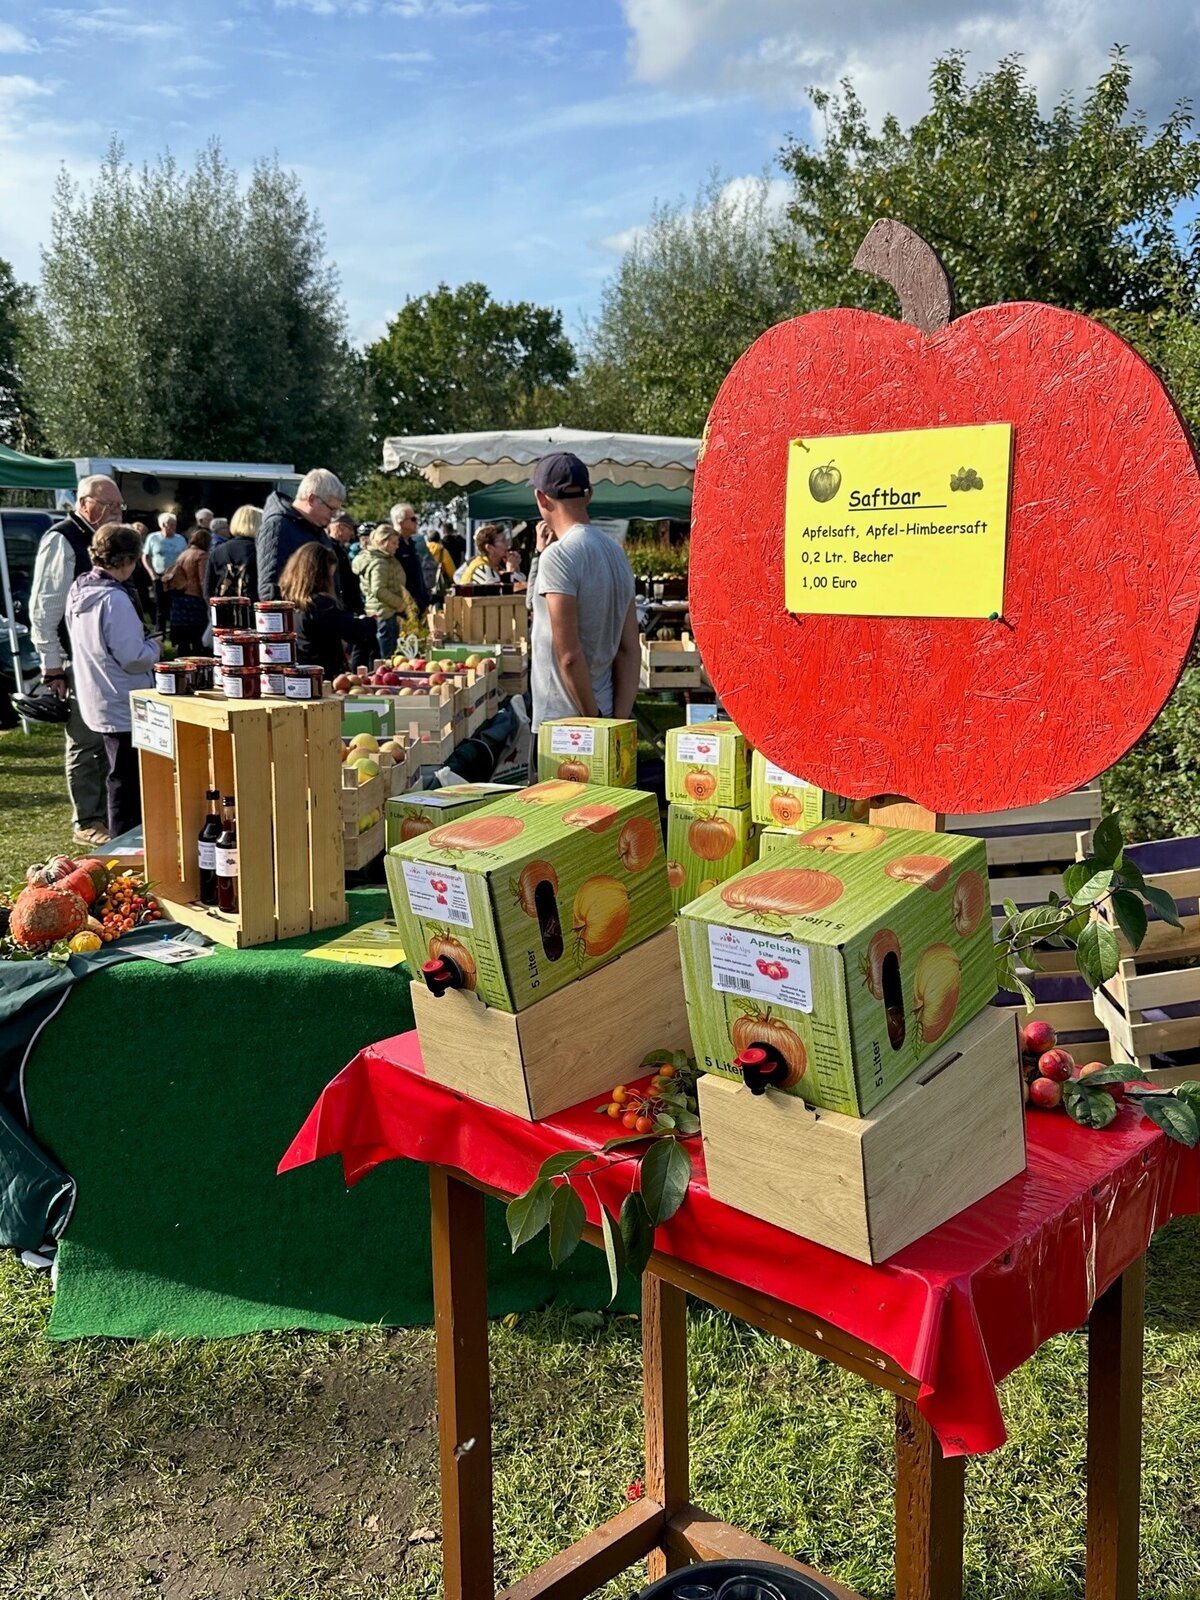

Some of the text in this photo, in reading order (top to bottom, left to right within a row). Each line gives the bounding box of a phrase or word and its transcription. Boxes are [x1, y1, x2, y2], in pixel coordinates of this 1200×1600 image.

[848, 488, 921, 507] Saftbar
[802, 520, 988, 539] Apfelsaft, Apfel-Himbeersaft
[801, 550, 894, 564] 0,2 Ltr. Becher
[802, 576, 857, 590] 1,00 Euro
[797, 915, 845, 931] 5 Liter
[750, 937, 802, 956] Apfelsaft
[528, 951, 540, 988] 5 Liter
[705, 1056, 744, 1076] 5 Liter
[872, 1041, 884, 1088] 5 Liter
